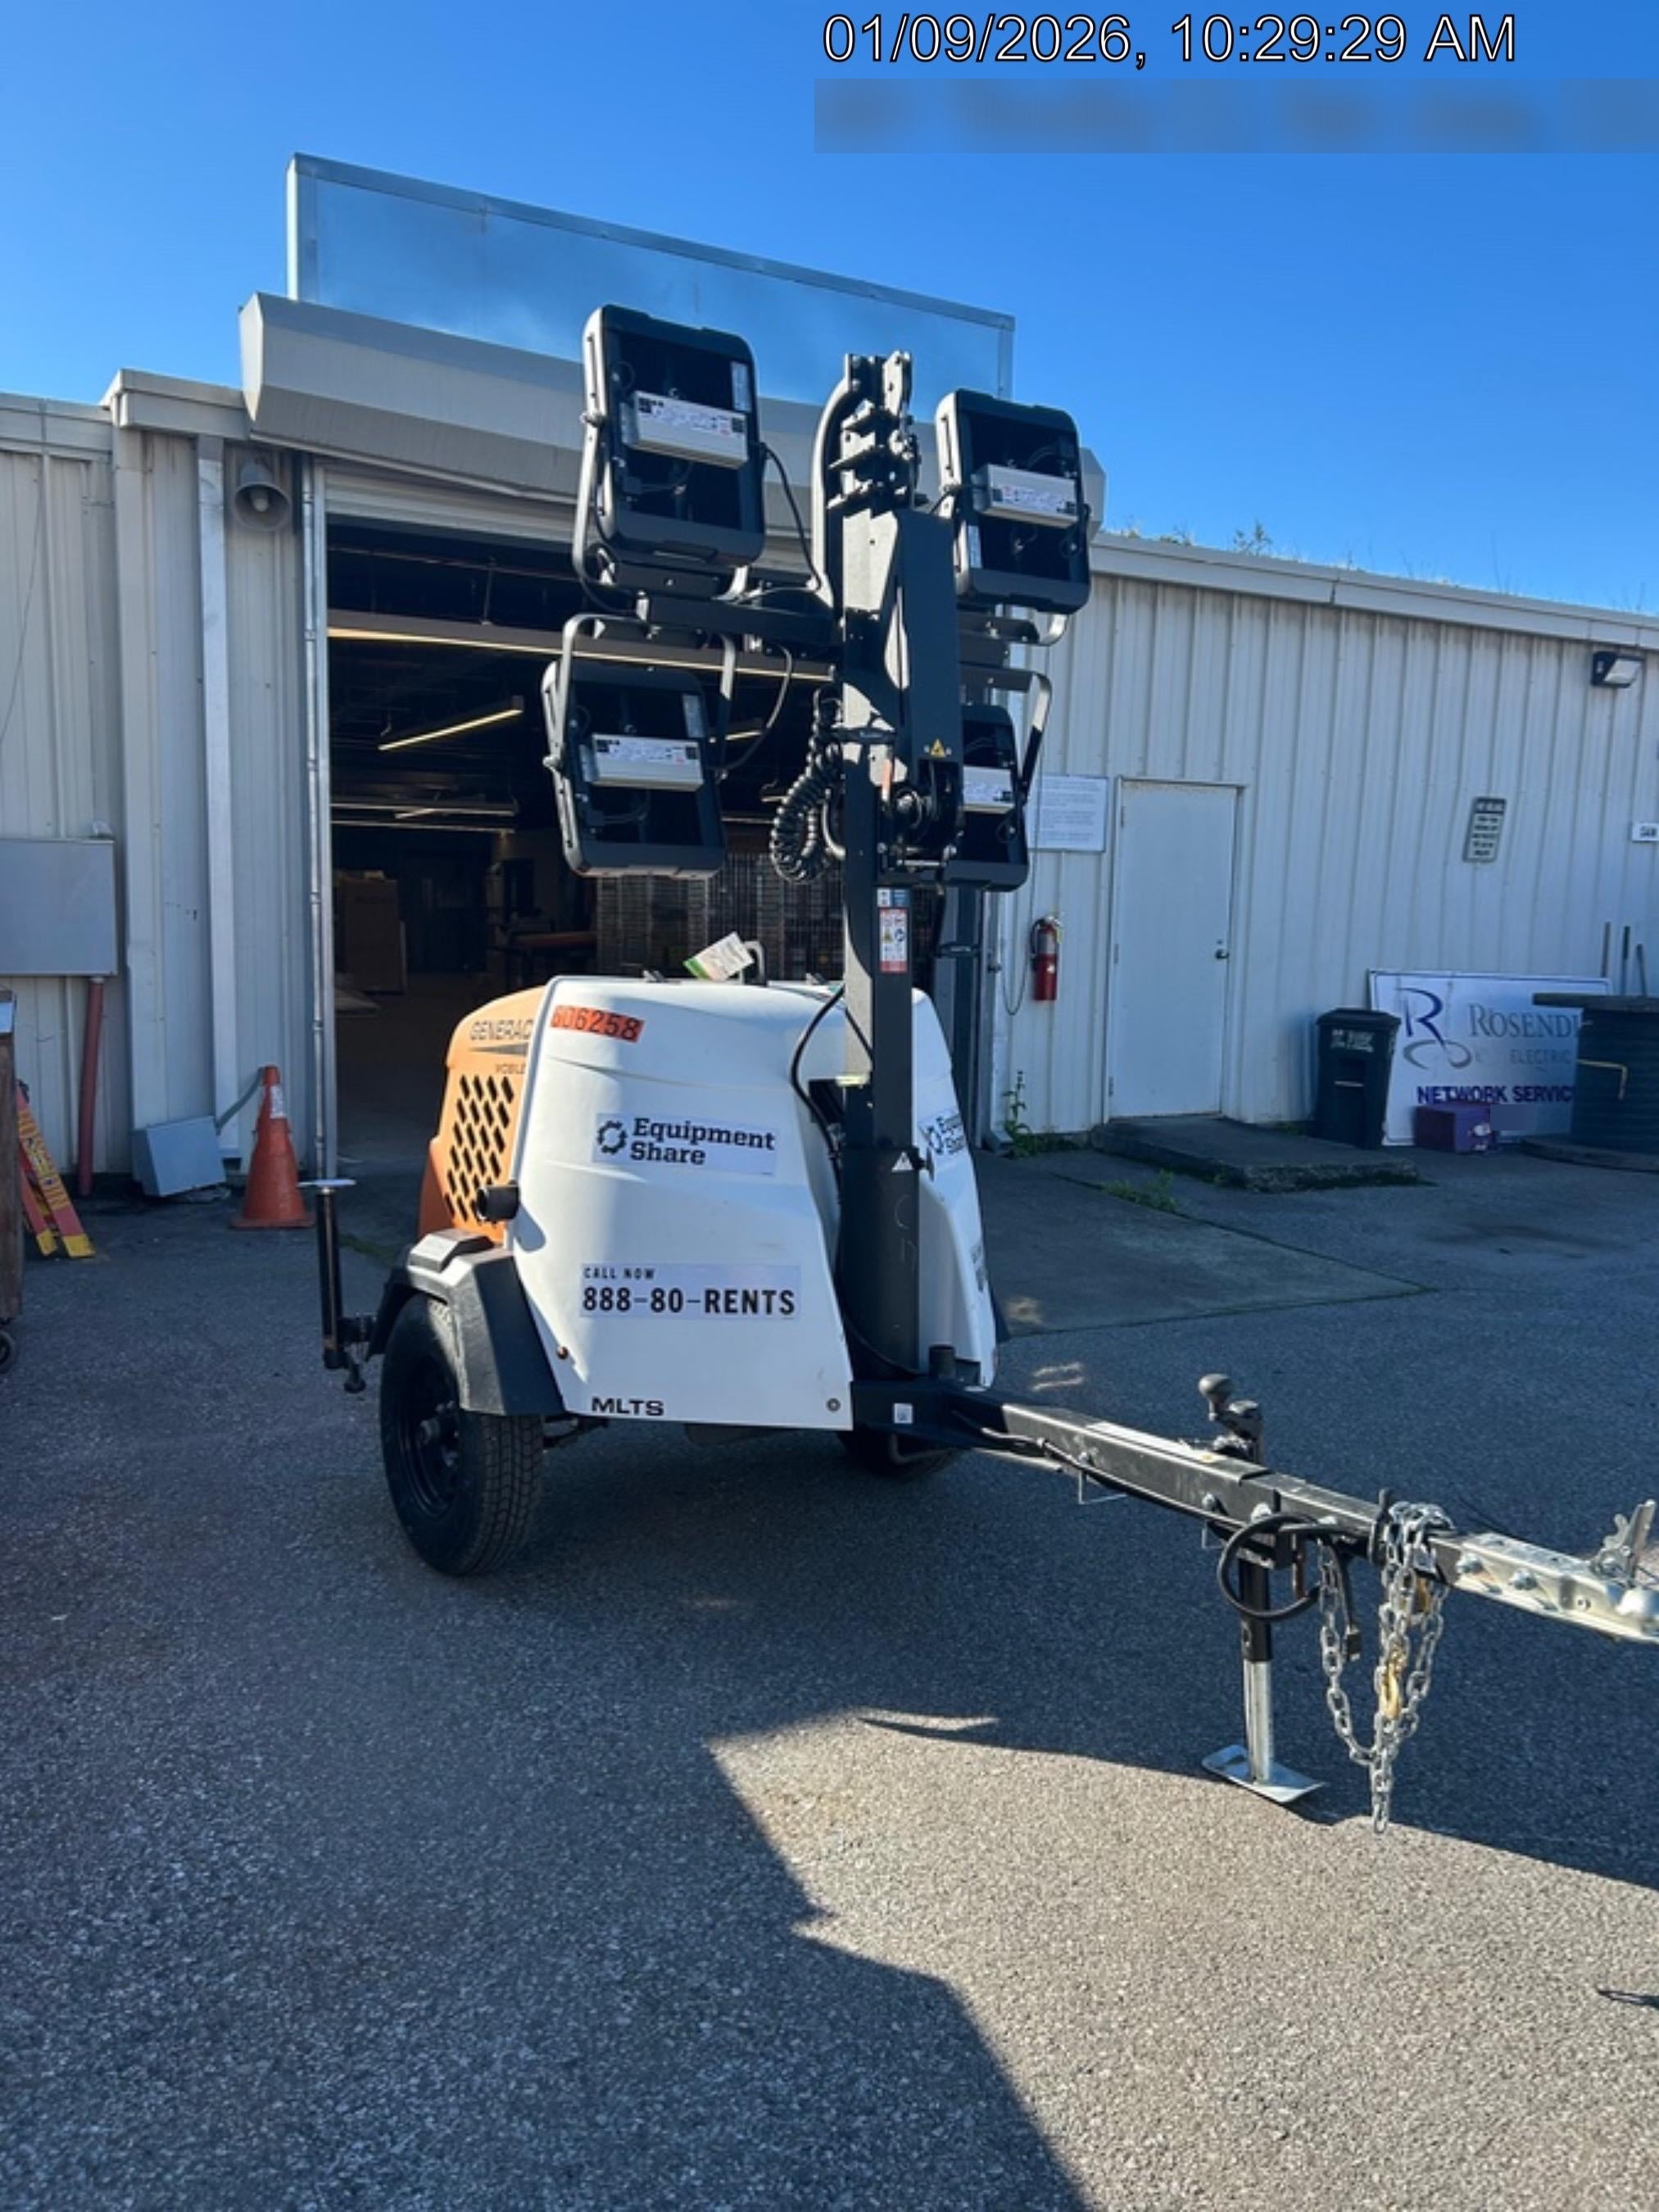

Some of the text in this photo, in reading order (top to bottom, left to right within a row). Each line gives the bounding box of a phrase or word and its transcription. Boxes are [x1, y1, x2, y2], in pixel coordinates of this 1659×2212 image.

[1416, 1086, 1508, 1104] NETWORK
[632, 1117, 775, 1150] Equipment
[630, 1141, 706, 1165] Share
[582, 1267, 655, 1280] CALL NOW
[582, 1287, 796, 1316] 888-80-RENTS
[592, 1397, 664, 1416] MLTS
